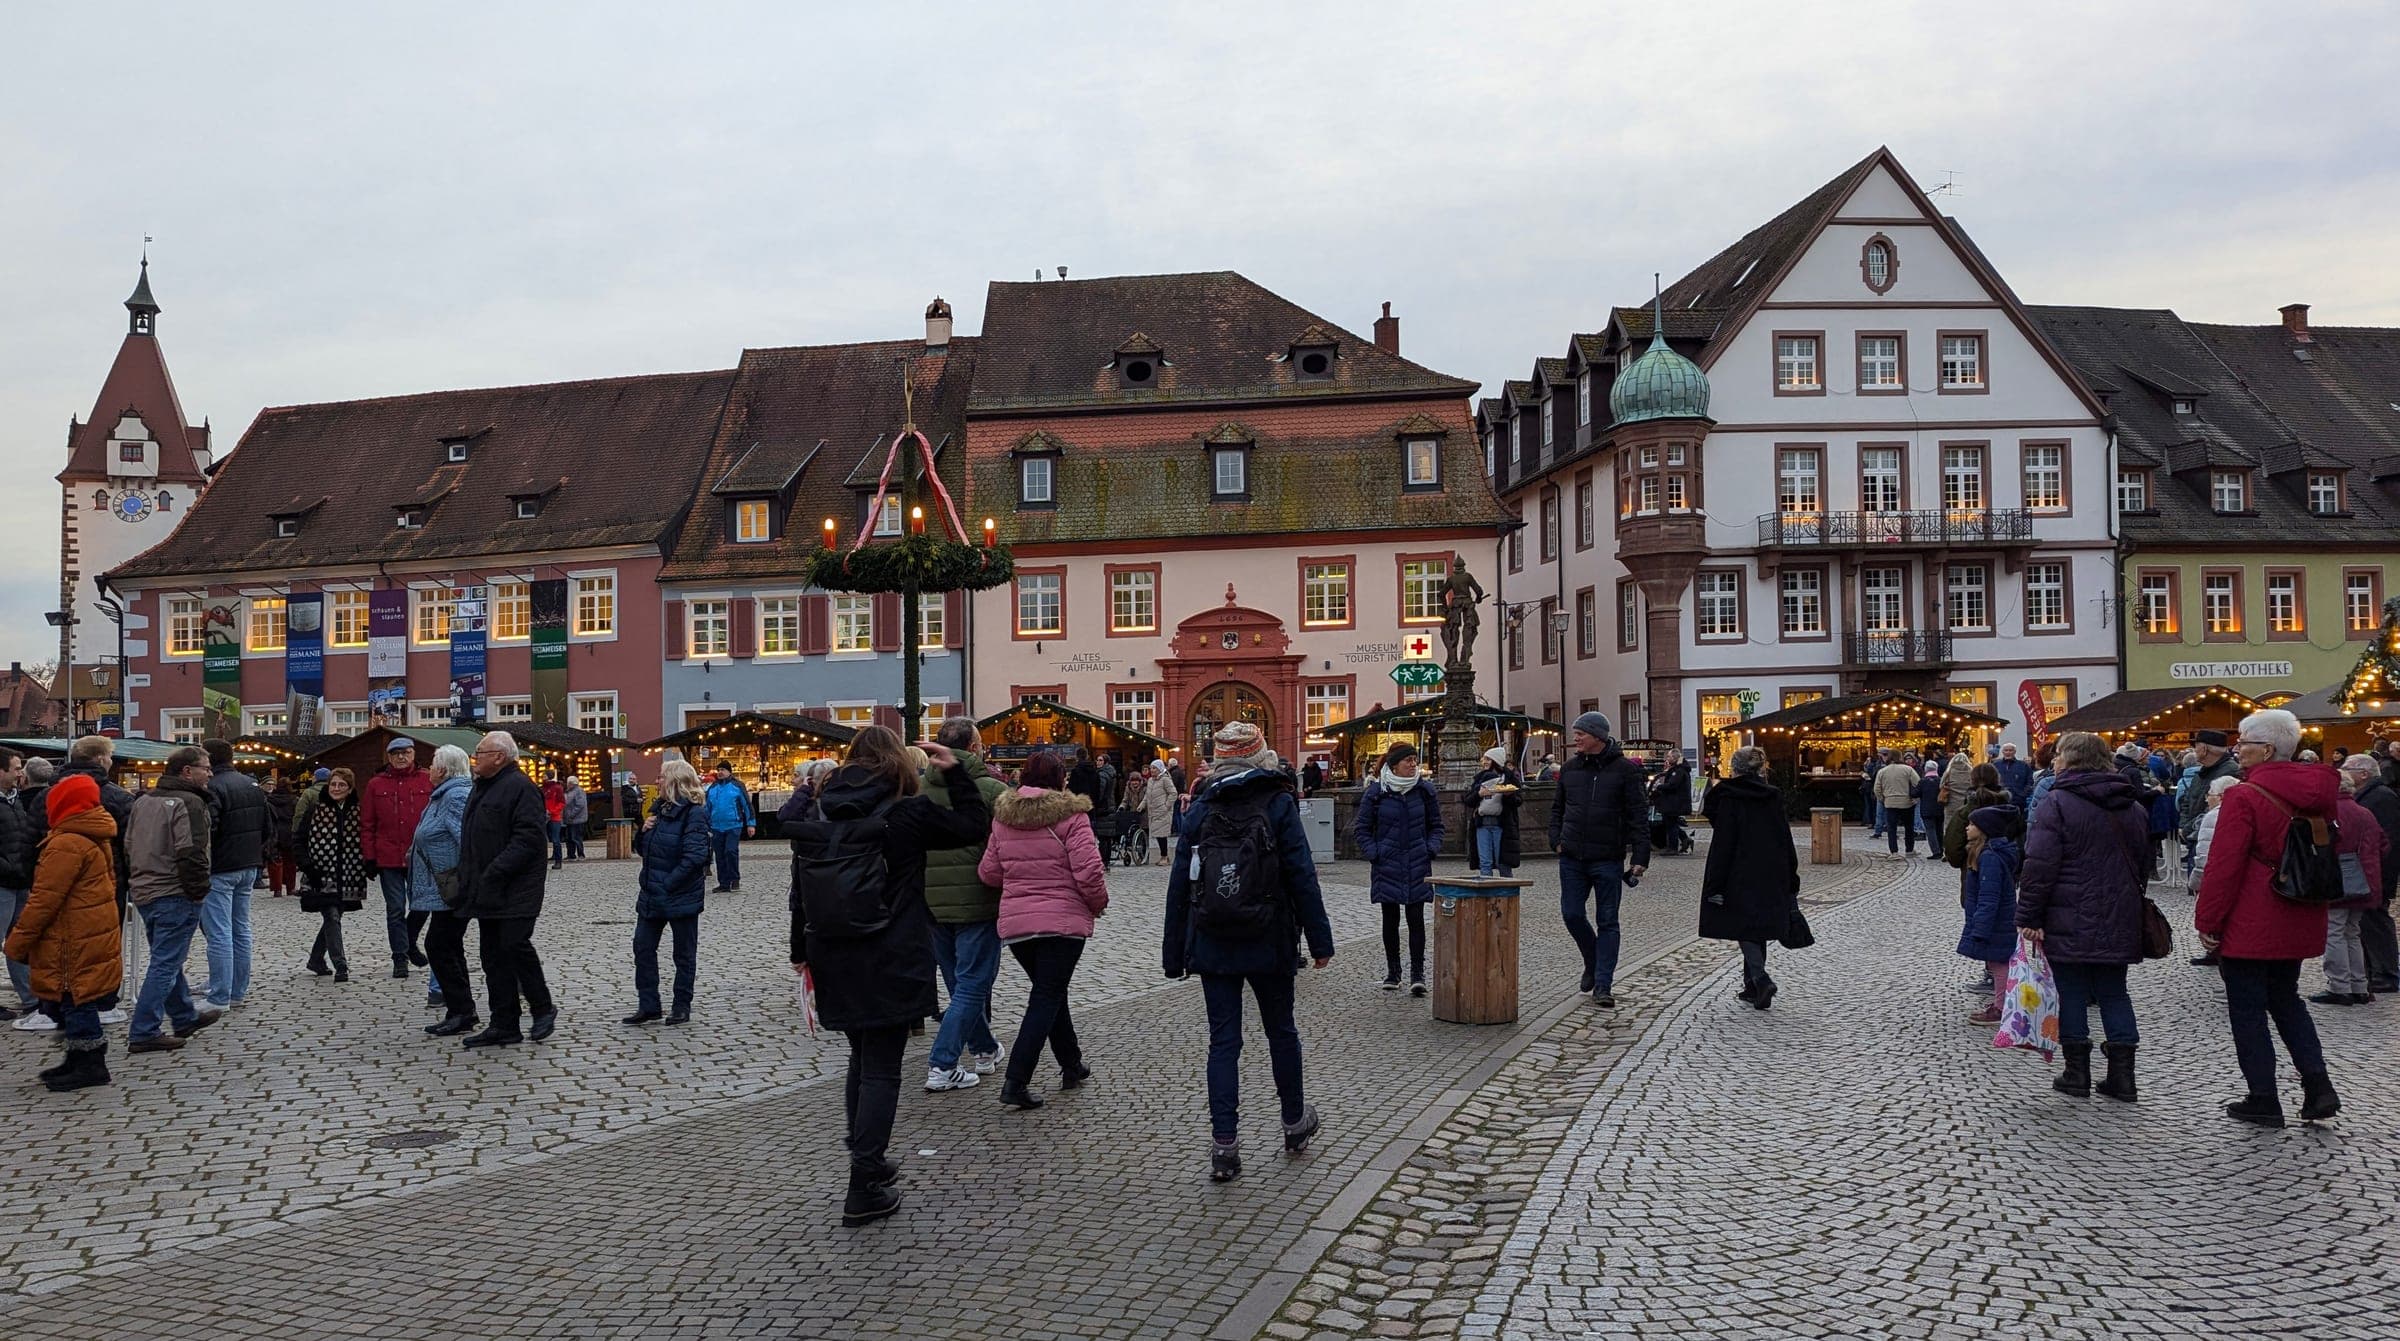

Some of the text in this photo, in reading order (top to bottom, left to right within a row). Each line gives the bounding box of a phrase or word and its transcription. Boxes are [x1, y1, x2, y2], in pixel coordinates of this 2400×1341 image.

[1356, 643, 1398, 653] MUSEUM
[1072, 652, 1101, 662] ALTES
[1345, 652, 1404, 664] TOURIST INF
[1061, 662, 1111, 673] KAUFHAUS
[1742, 691, 1760, 702] WC
[2045, 706, 2065, 714] SLER
[1704, 716, 1738, 725] GIESLER
